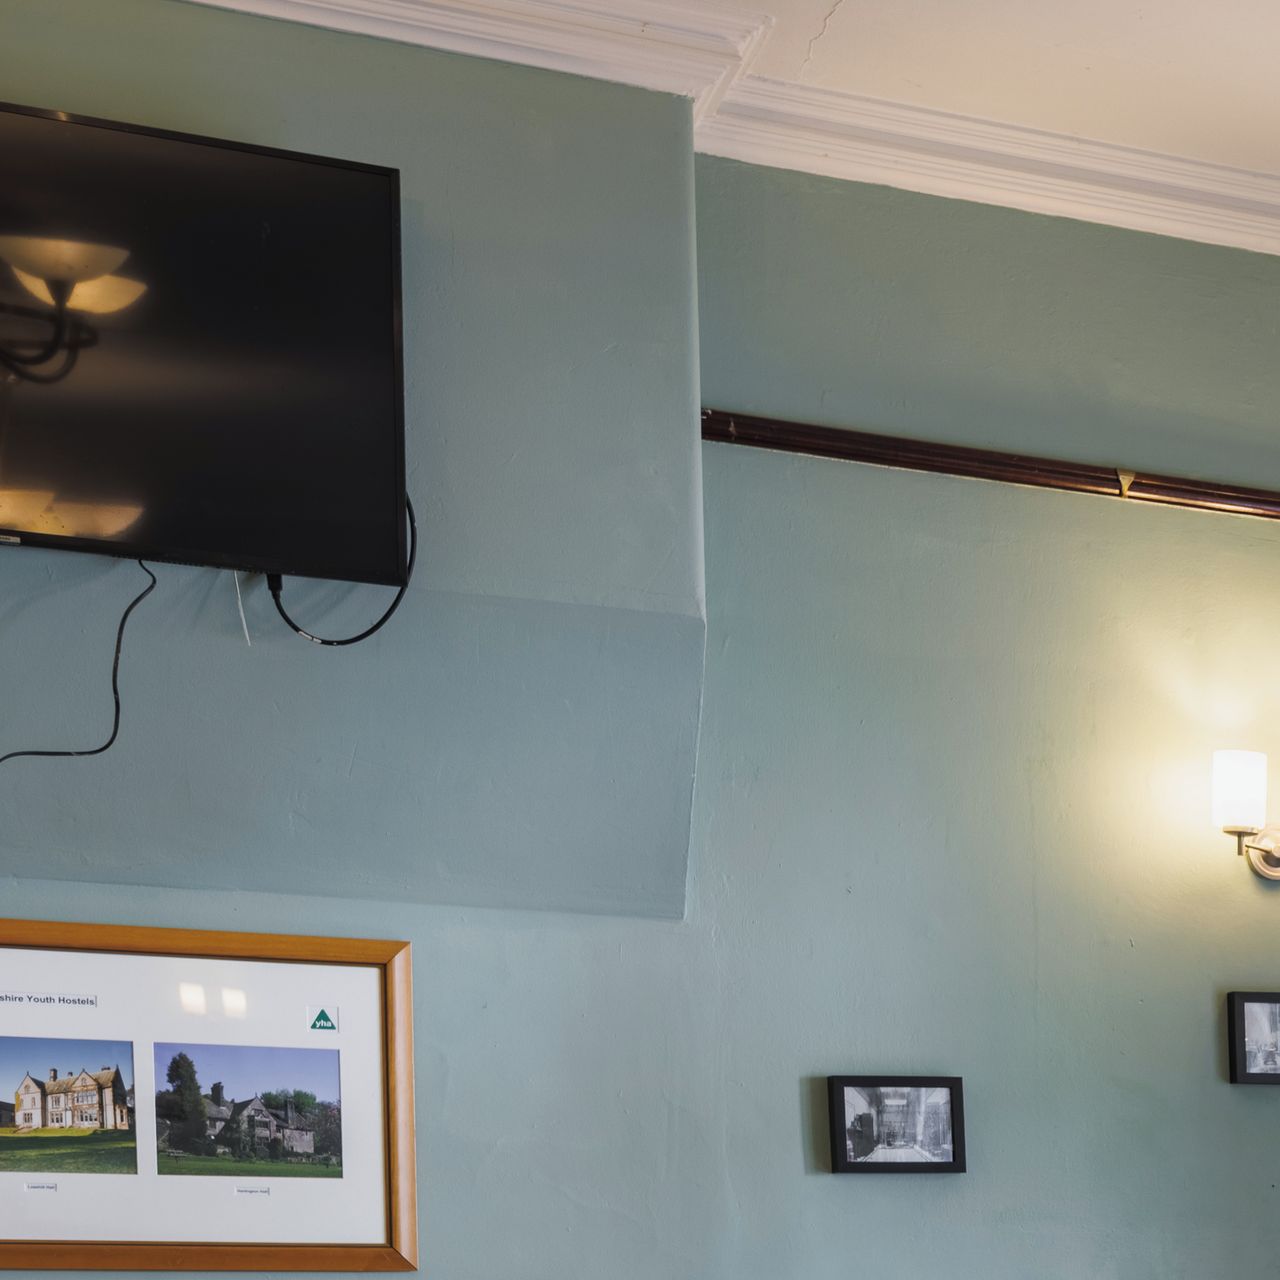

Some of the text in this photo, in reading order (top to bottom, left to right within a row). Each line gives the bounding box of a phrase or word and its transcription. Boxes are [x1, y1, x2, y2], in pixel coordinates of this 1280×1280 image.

[27, 995, 55, 1004] Youth
[58, 996, 95, 1006] Hostels
[315, 1019, 332, 1028] yha
